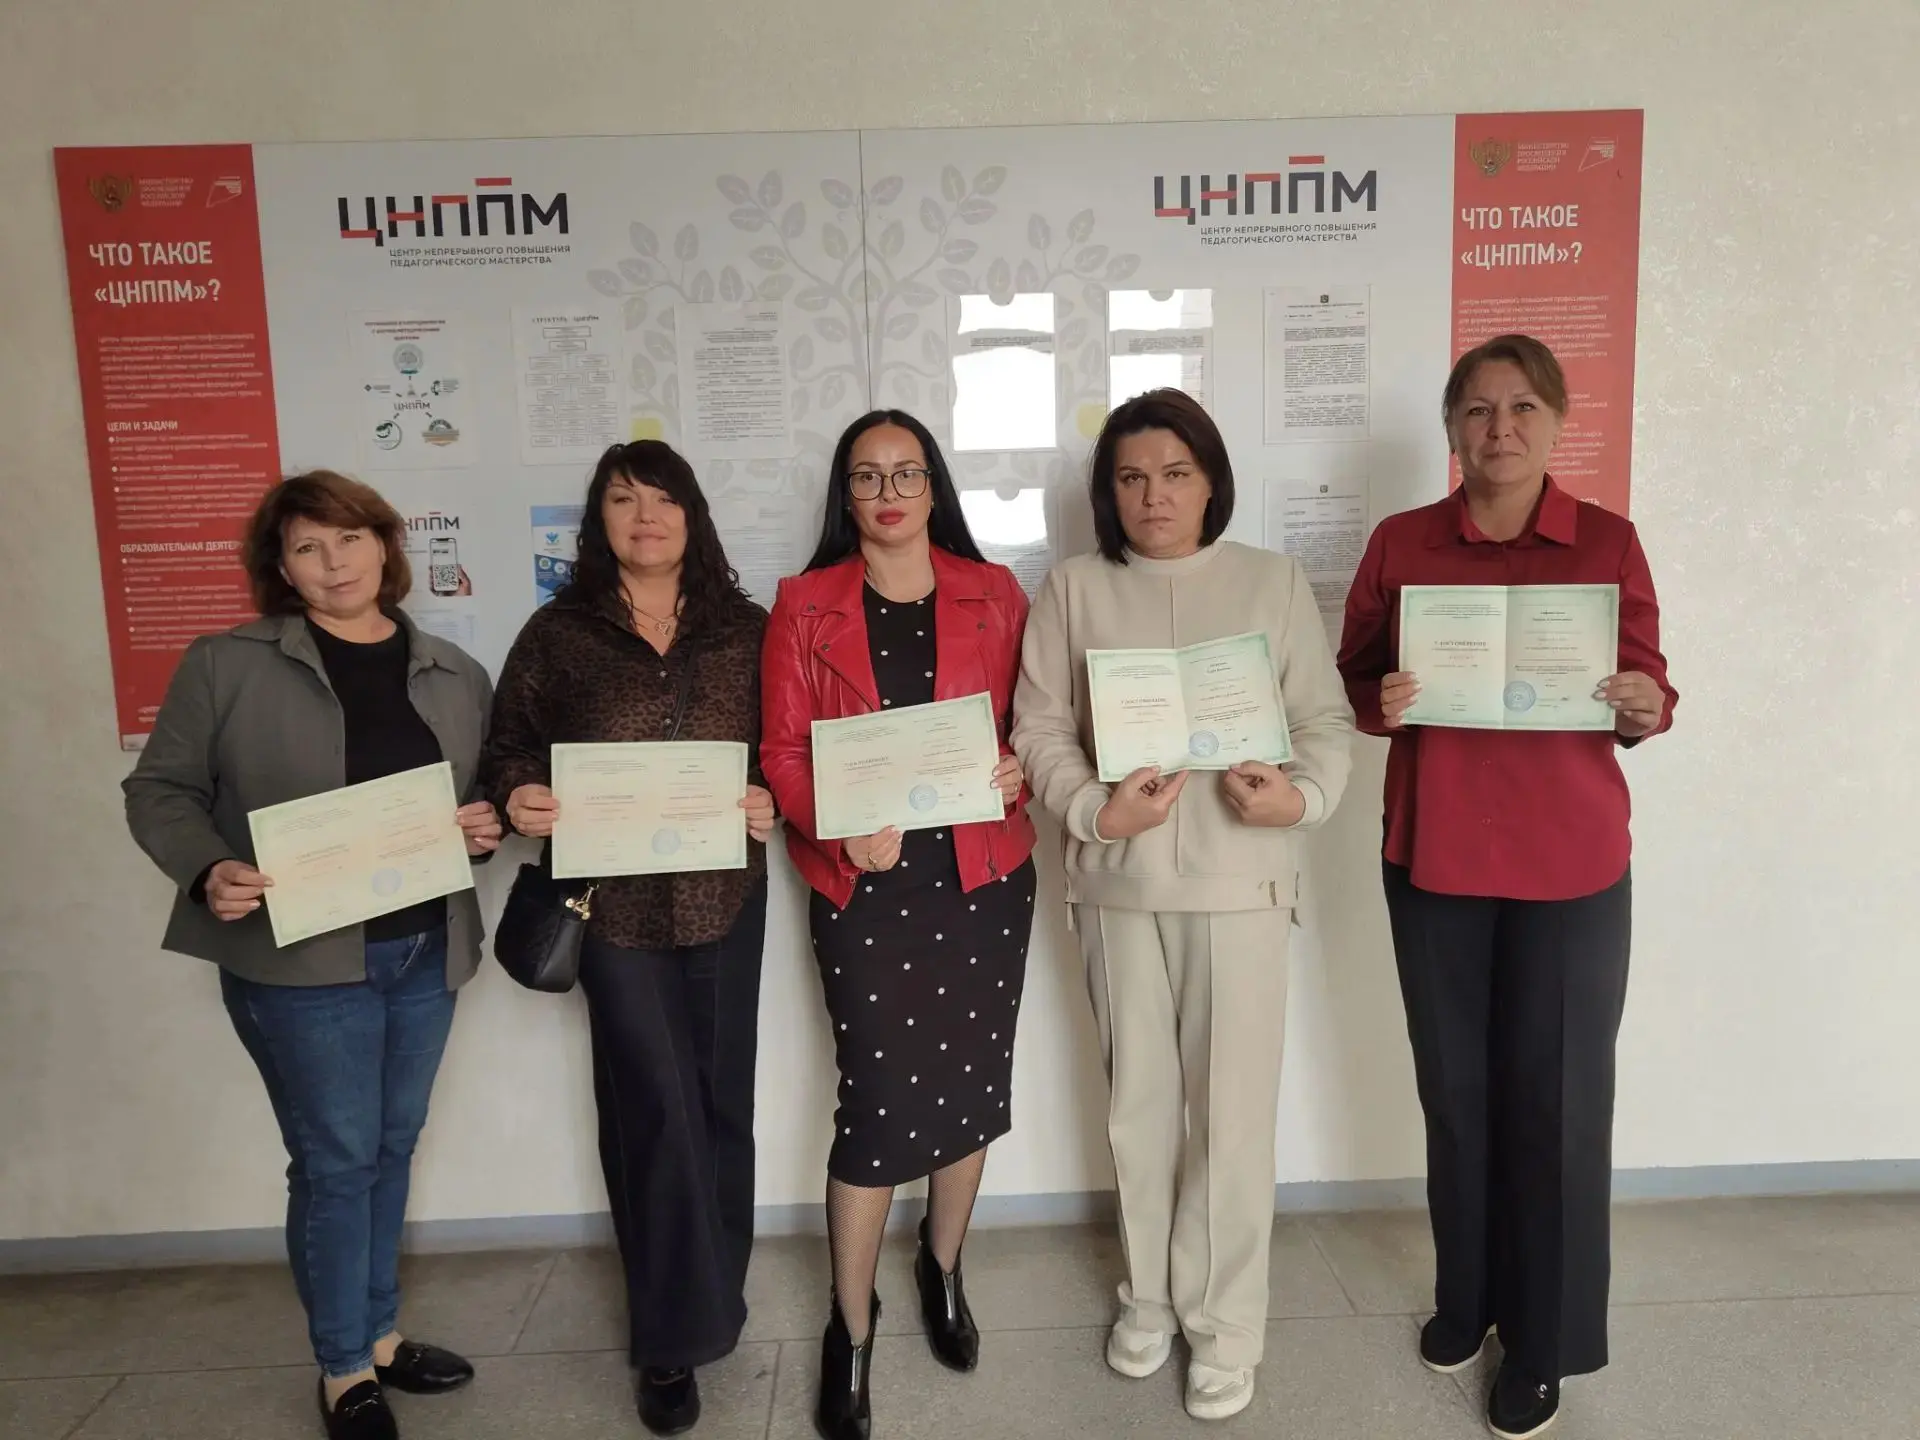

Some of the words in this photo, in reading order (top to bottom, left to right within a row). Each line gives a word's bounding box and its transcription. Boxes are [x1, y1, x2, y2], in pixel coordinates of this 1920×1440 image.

[1154, 155, 1377, 225] ЦНППМ
[338, 177, 569, 247] ЦНППМ
[1461, 207, 1502, 230] ЧТО
[1509, 204, 1579, 229] ТАКОЕ
[1200, 226, 1231, 236] ЦЕНТР
[1234, 225, 1312, 235] НЕПРЕРЫВНОГО
[1315, 222, 1377, 232] ПОВЫШЕНИЯ
[1201, 235, 1294, 246] ПЕДАГОГИЧЕСКОГО
[1297, 233, 1358, 243] МАСТЕРСТВА
[89, 243, 133, 267] ЧТО
[138, 241, 213, 266] ТАКОЕ
[389, 248, 421, 258] ЦЕНТР
[424, 246, 504, 257] НЕПРЕРЫВНОГО
[506, 245, 571, 255] ПОВЫШЕНИЯ
[390, 257, 486, 268] ПЕДАГОГИЧЕСКОГО
[488, 256, 552, 266] МАСТЕРСТВА
[1460, 241, 1583, 271] «ЦНППМ»?
[94, 278, 221, 308] «ЦНППМ»?
[107, 421, 132, 432] ЦЕЛИ
[133, 421, 140, 431] И
[142, 420, 178, 432] ЗАДАЧИ
[404, 511, 460, 531] НППМ
